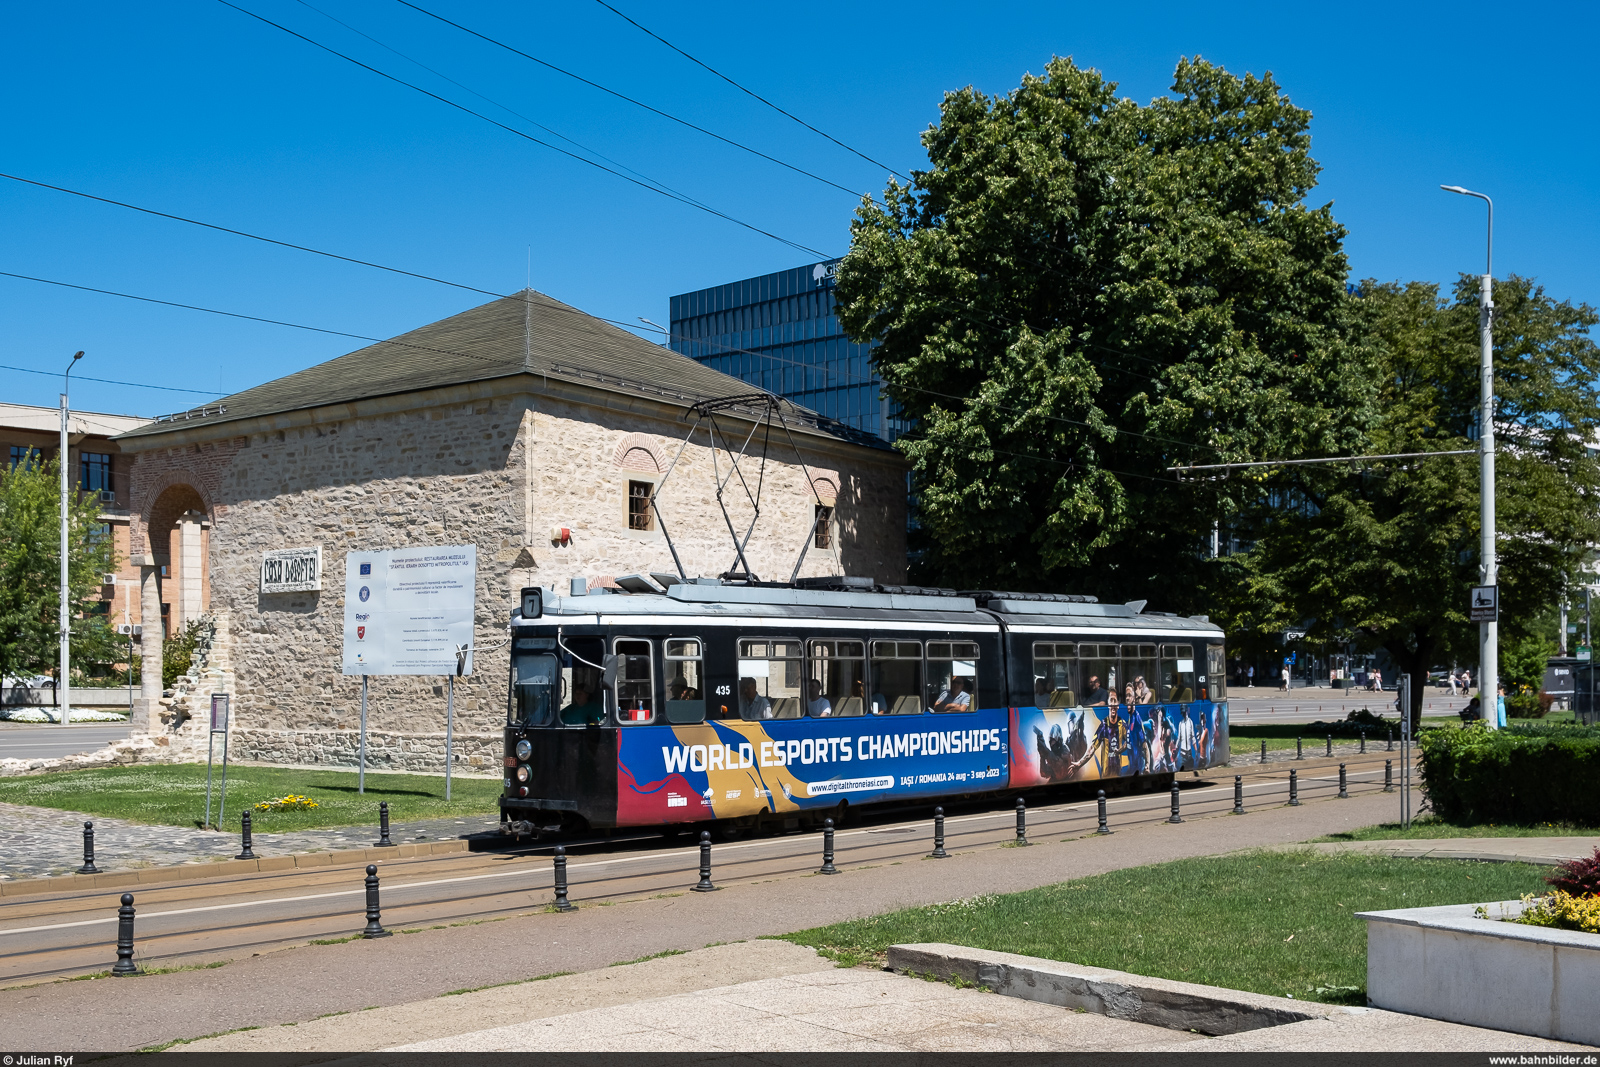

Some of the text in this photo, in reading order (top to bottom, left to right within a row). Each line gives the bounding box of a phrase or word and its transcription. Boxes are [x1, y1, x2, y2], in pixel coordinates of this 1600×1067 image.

[528, 598, 535, 613] 7
[355, 612, 371, 621] Regio
[715, 685, 731, 696] 435
[661, 742, 754, 774] WORLD
[760, 736, 853, 768] ESPORTS
[857, 728, 1000, 761] CHAMPIONSHIPS
[919, 773, 947, 784] ROMANIA
[947, 772, 955, 781] 24
[955, 773, 967, 782] aug
[970, 770, 975, 779] 3
[975, 771, 986, 780] sep
[986, 768, 1000, 778] 2023
[811, 778, 889, 793] www.digitalthroneiasi.com
